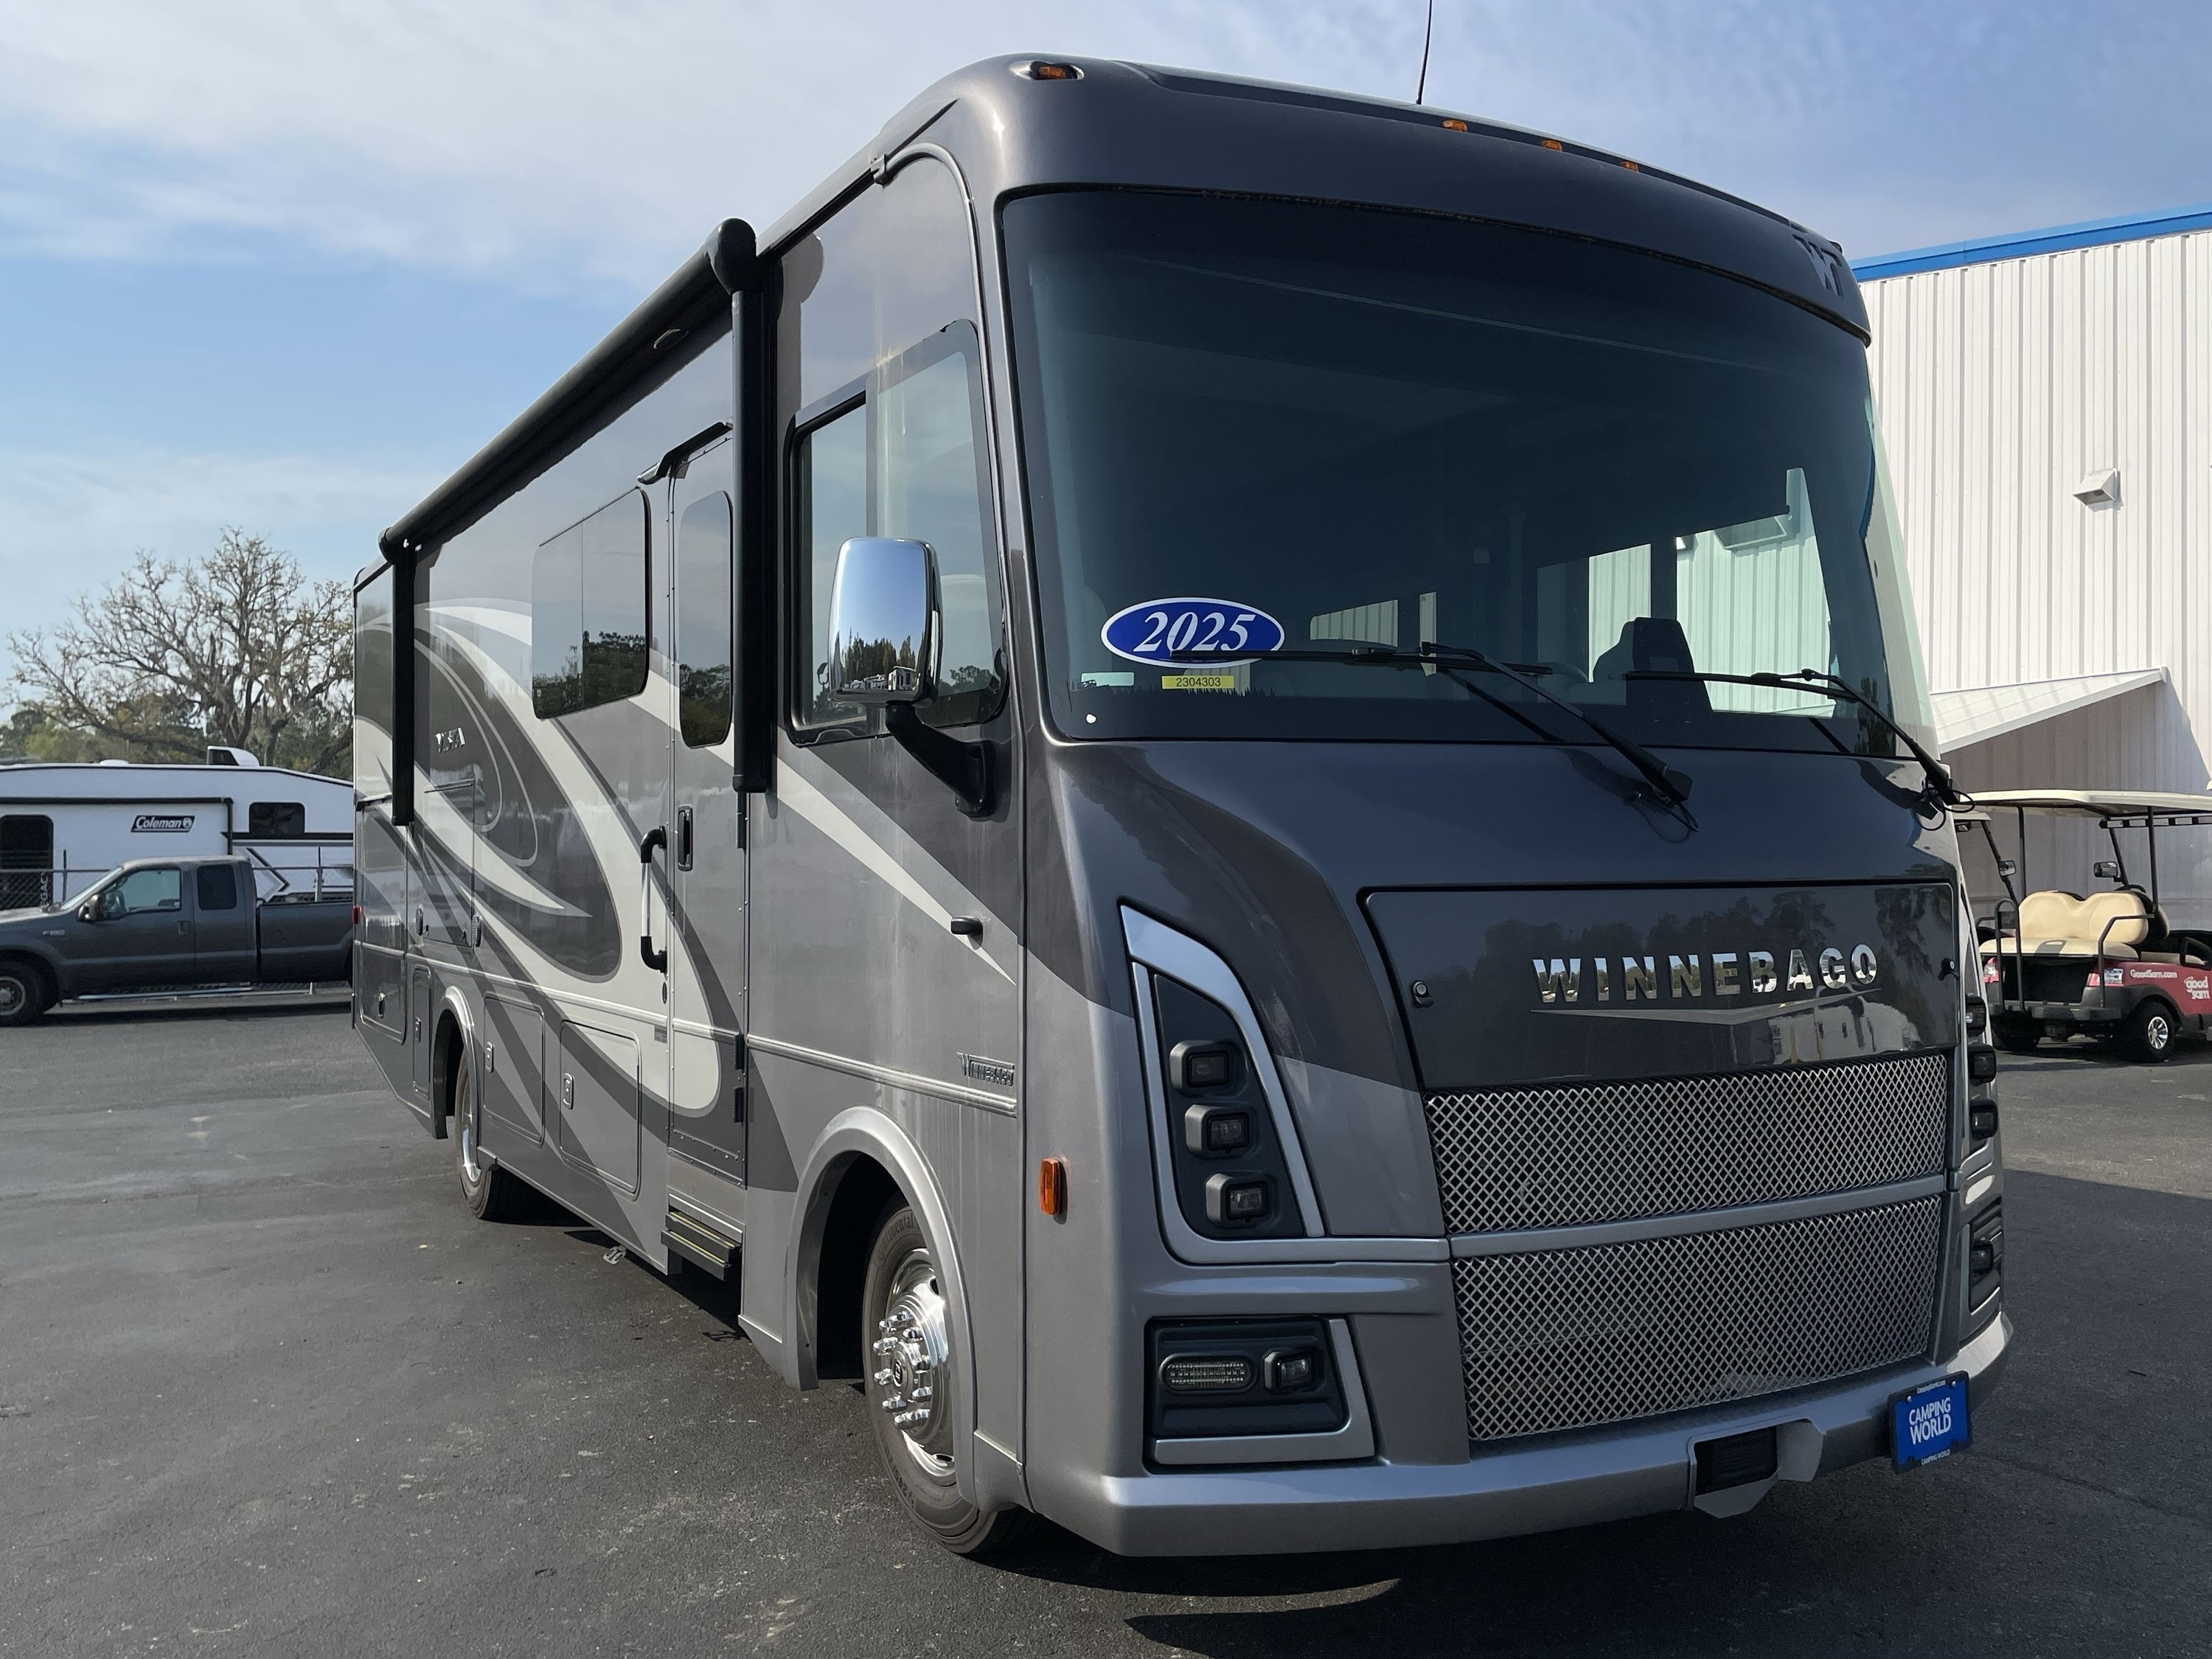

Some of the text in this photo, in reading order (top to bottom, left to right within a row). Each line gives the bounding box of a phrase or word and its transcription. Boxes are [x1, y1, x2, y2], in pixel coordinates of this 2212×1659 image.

[1133, 612, 1256, 652] 2025
[1176, 677, 1221, 687] 2304303
[136, 816, 182, 829] Coleman
[1532, 944, 1878, 1003] WINNEBAGO
[2130, 969, 2177, 978] GoodSam.com
[2184, 976, 2209, 992] good
[2191, 989, 2211, 1000] sam
[1908, 1397, 1951, 1426] CAMPING
[1910, 1413, 1952, 1445] WORLD
